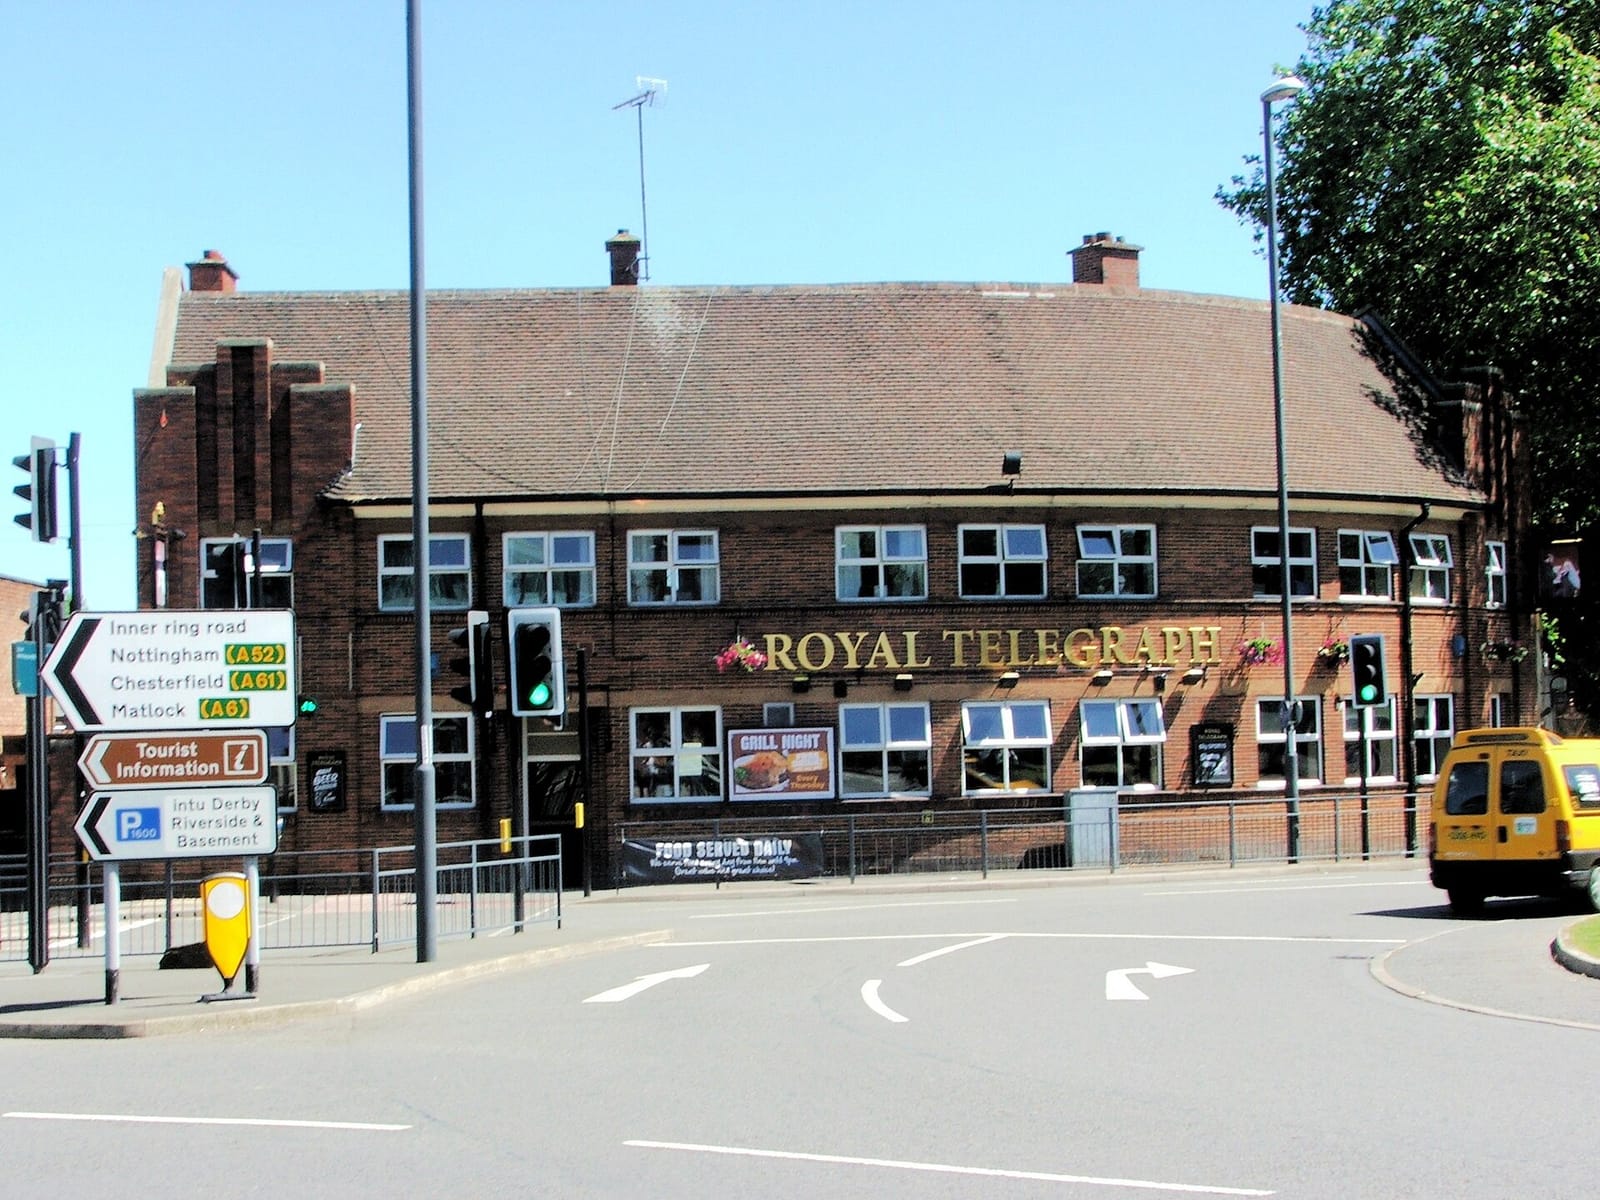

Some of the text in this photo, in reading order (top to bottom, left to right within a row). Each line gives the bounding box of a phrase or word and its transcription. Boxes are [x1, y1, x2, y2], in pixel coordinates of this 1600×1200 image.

[111, 619, 247, 637] Inner ring road
[111, 645, 286, 665] Nottingham (A52)
[763, 626, 1222, 671] ROYAL TELEGRAPH
[111, 672, 286, 691] Chesterfield (A61)
[112, 700, 248, 718] Matlock (A6)
[136, 742, 198, 758] Tourist
[741, 734, 820, 750] GRILL NIGHT
[117, 762, 220, 778] Information
[212, 797, 260, 812] Derby
[121, 811, 142, 839] P
[172, 815, 263, 830] Riverside &
[177, 833, 259, 848] Basement
[655, 839, 792, 858] FOOD SERVED DAILY
